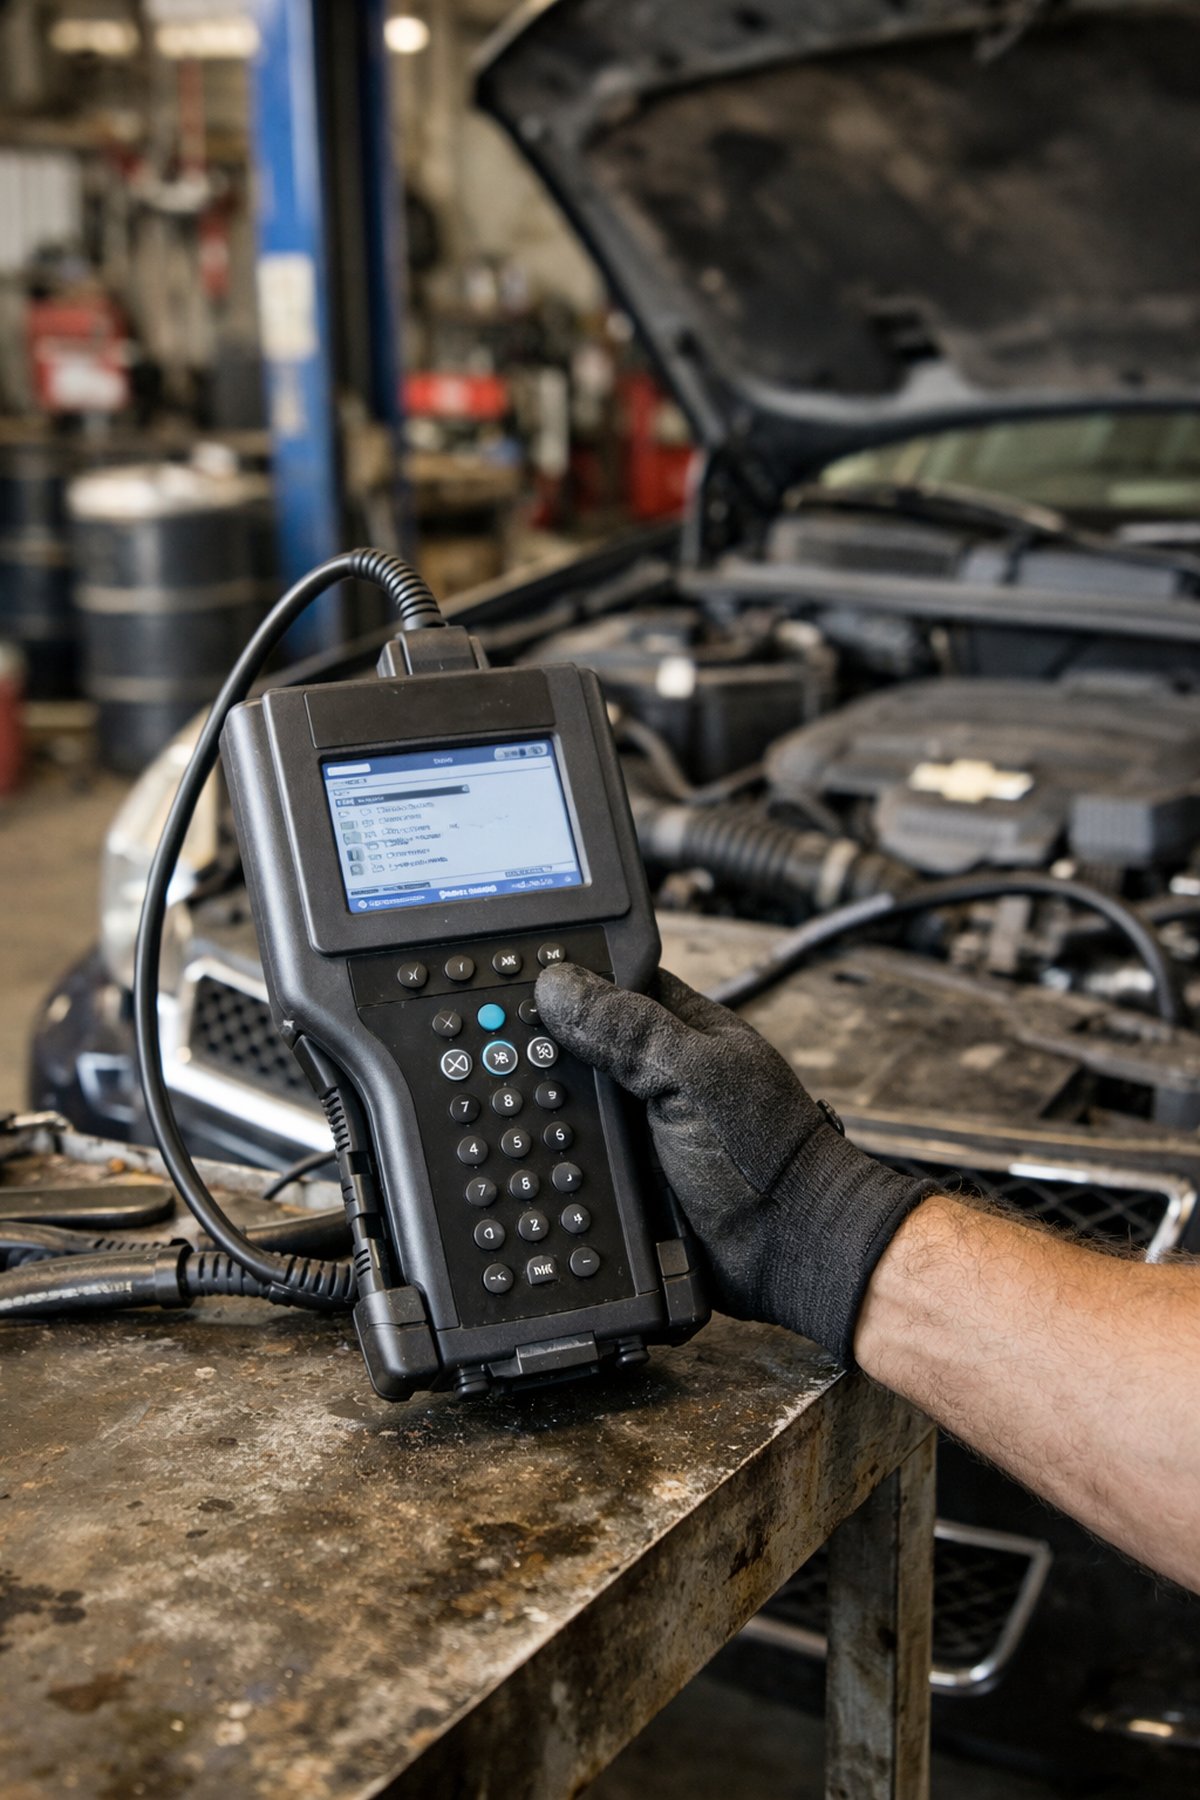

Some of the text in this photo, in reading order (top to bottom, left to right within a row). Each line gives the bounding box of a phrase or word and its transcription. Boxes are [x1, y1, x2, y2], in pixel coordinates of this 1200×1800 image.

[460, 1100, 470, 1113] 7
[503, 1094, 514, 1107] 8
[555, 1128, 565, 1141] 6
[469, 1142, 479, 1155] 4
[513, 1135, 522, 1149] 5
[477, 1183, 486, 1197] 7
[530, 1218, 541, 1232] 2
